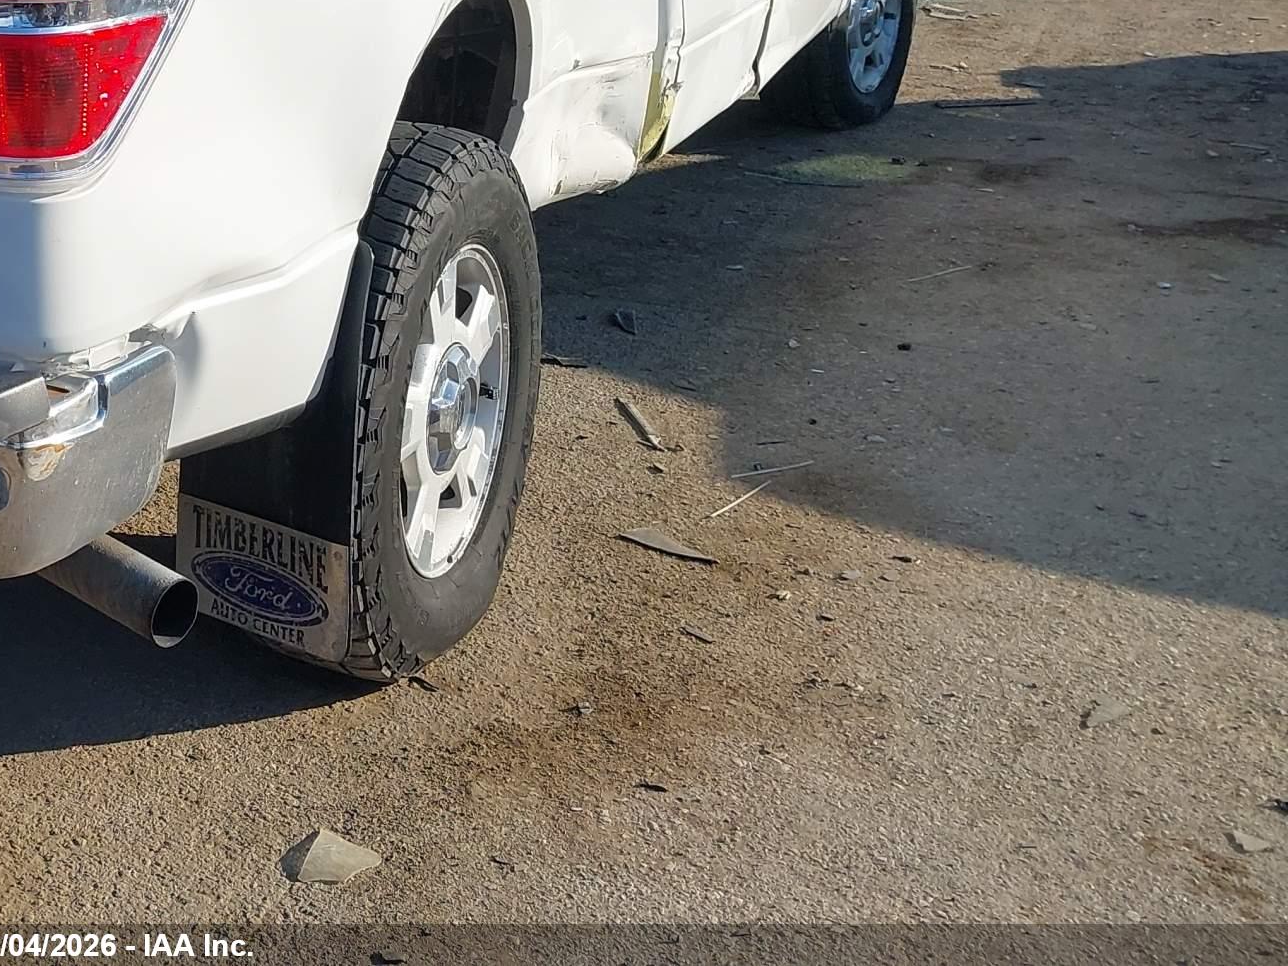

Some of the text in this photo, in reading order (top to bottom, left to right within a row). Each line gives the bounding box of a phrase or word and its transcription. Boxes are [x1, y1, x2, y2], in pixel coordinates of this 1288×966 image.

[192, 504, 329, 595] TIMBERLINE
[224, 565, 293, 611] Ford
[211, 597, 306, 647] AUTO CENTER
